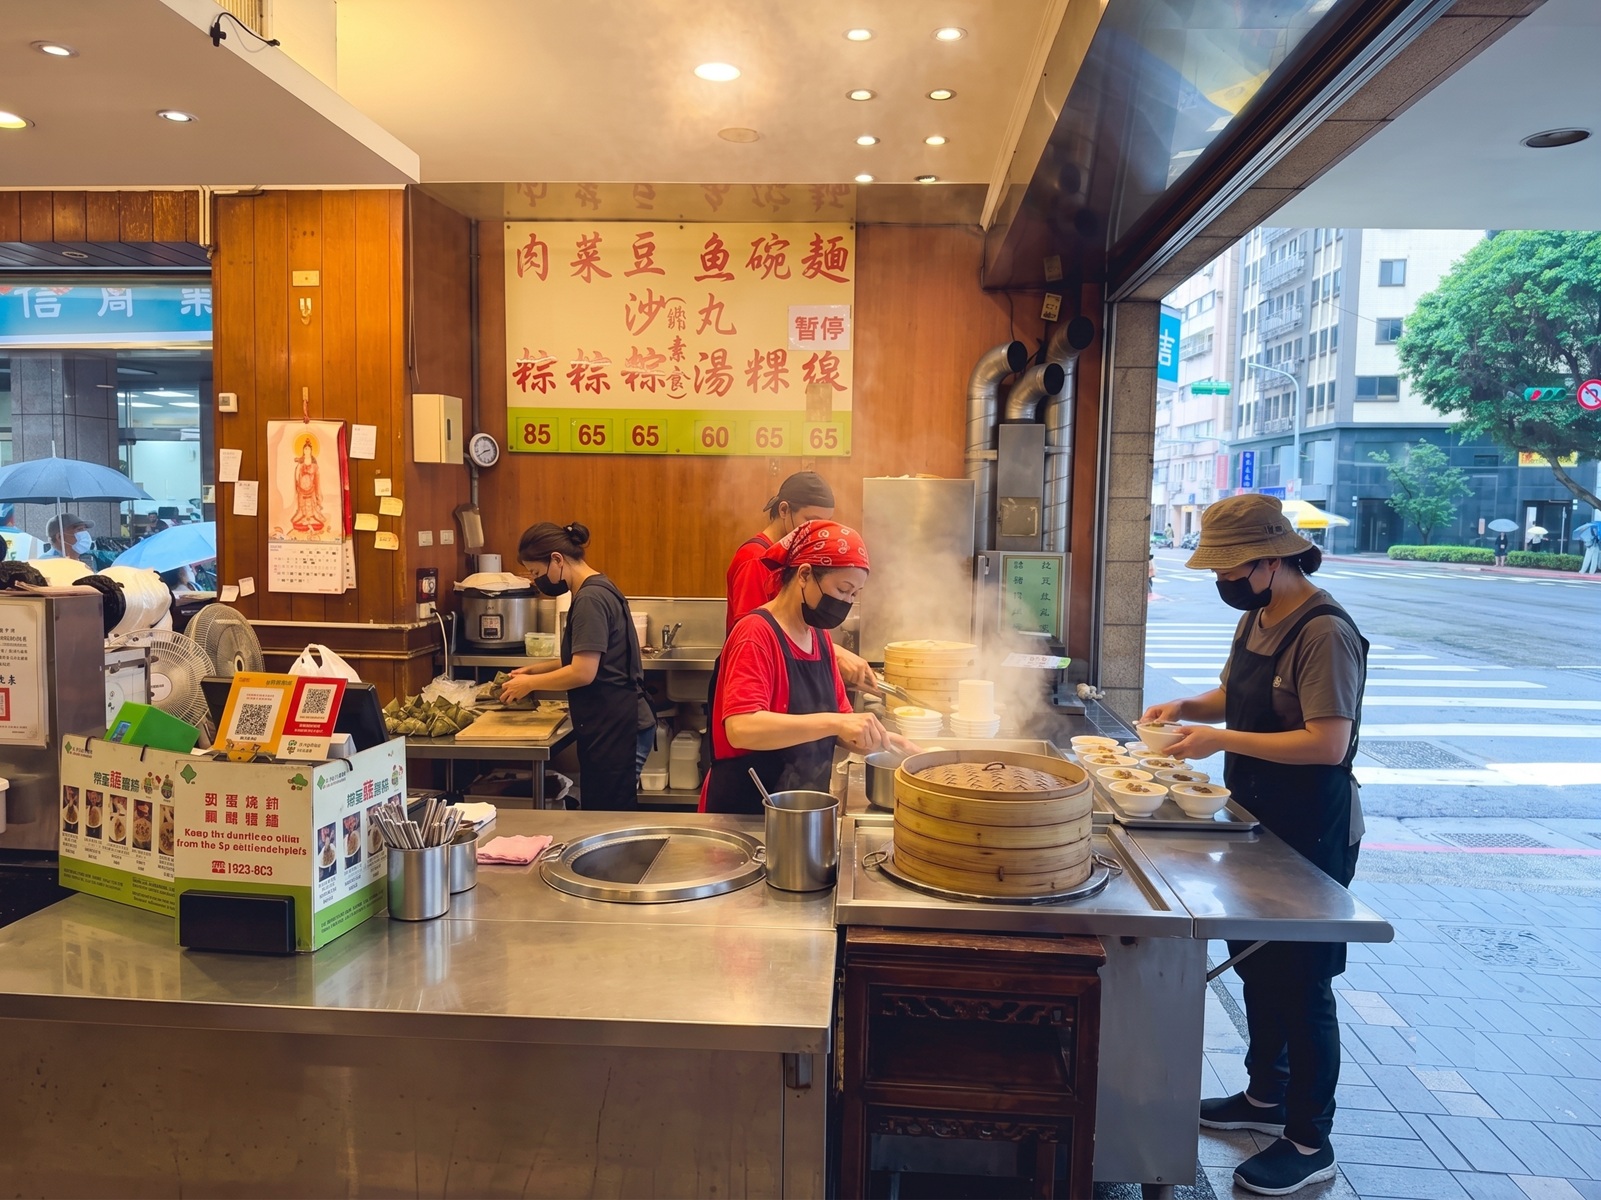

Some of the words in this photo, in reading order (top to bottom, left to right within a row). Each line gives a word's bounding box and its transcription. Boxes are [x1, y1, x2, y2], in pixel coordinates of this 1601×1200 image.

[795, 316, 844, 341] 暫停
[523, 423, 551, 445] 85
[578, 423, 606, 446] 65
[631, 424, 659, 447] 65
[701, 426, 729, 448] 60
[755, 427, 784, 449] 65
[810, 428, 838, 449] 65
[177, 838, 199, 848] from
[201, 840, 216, 849] the
